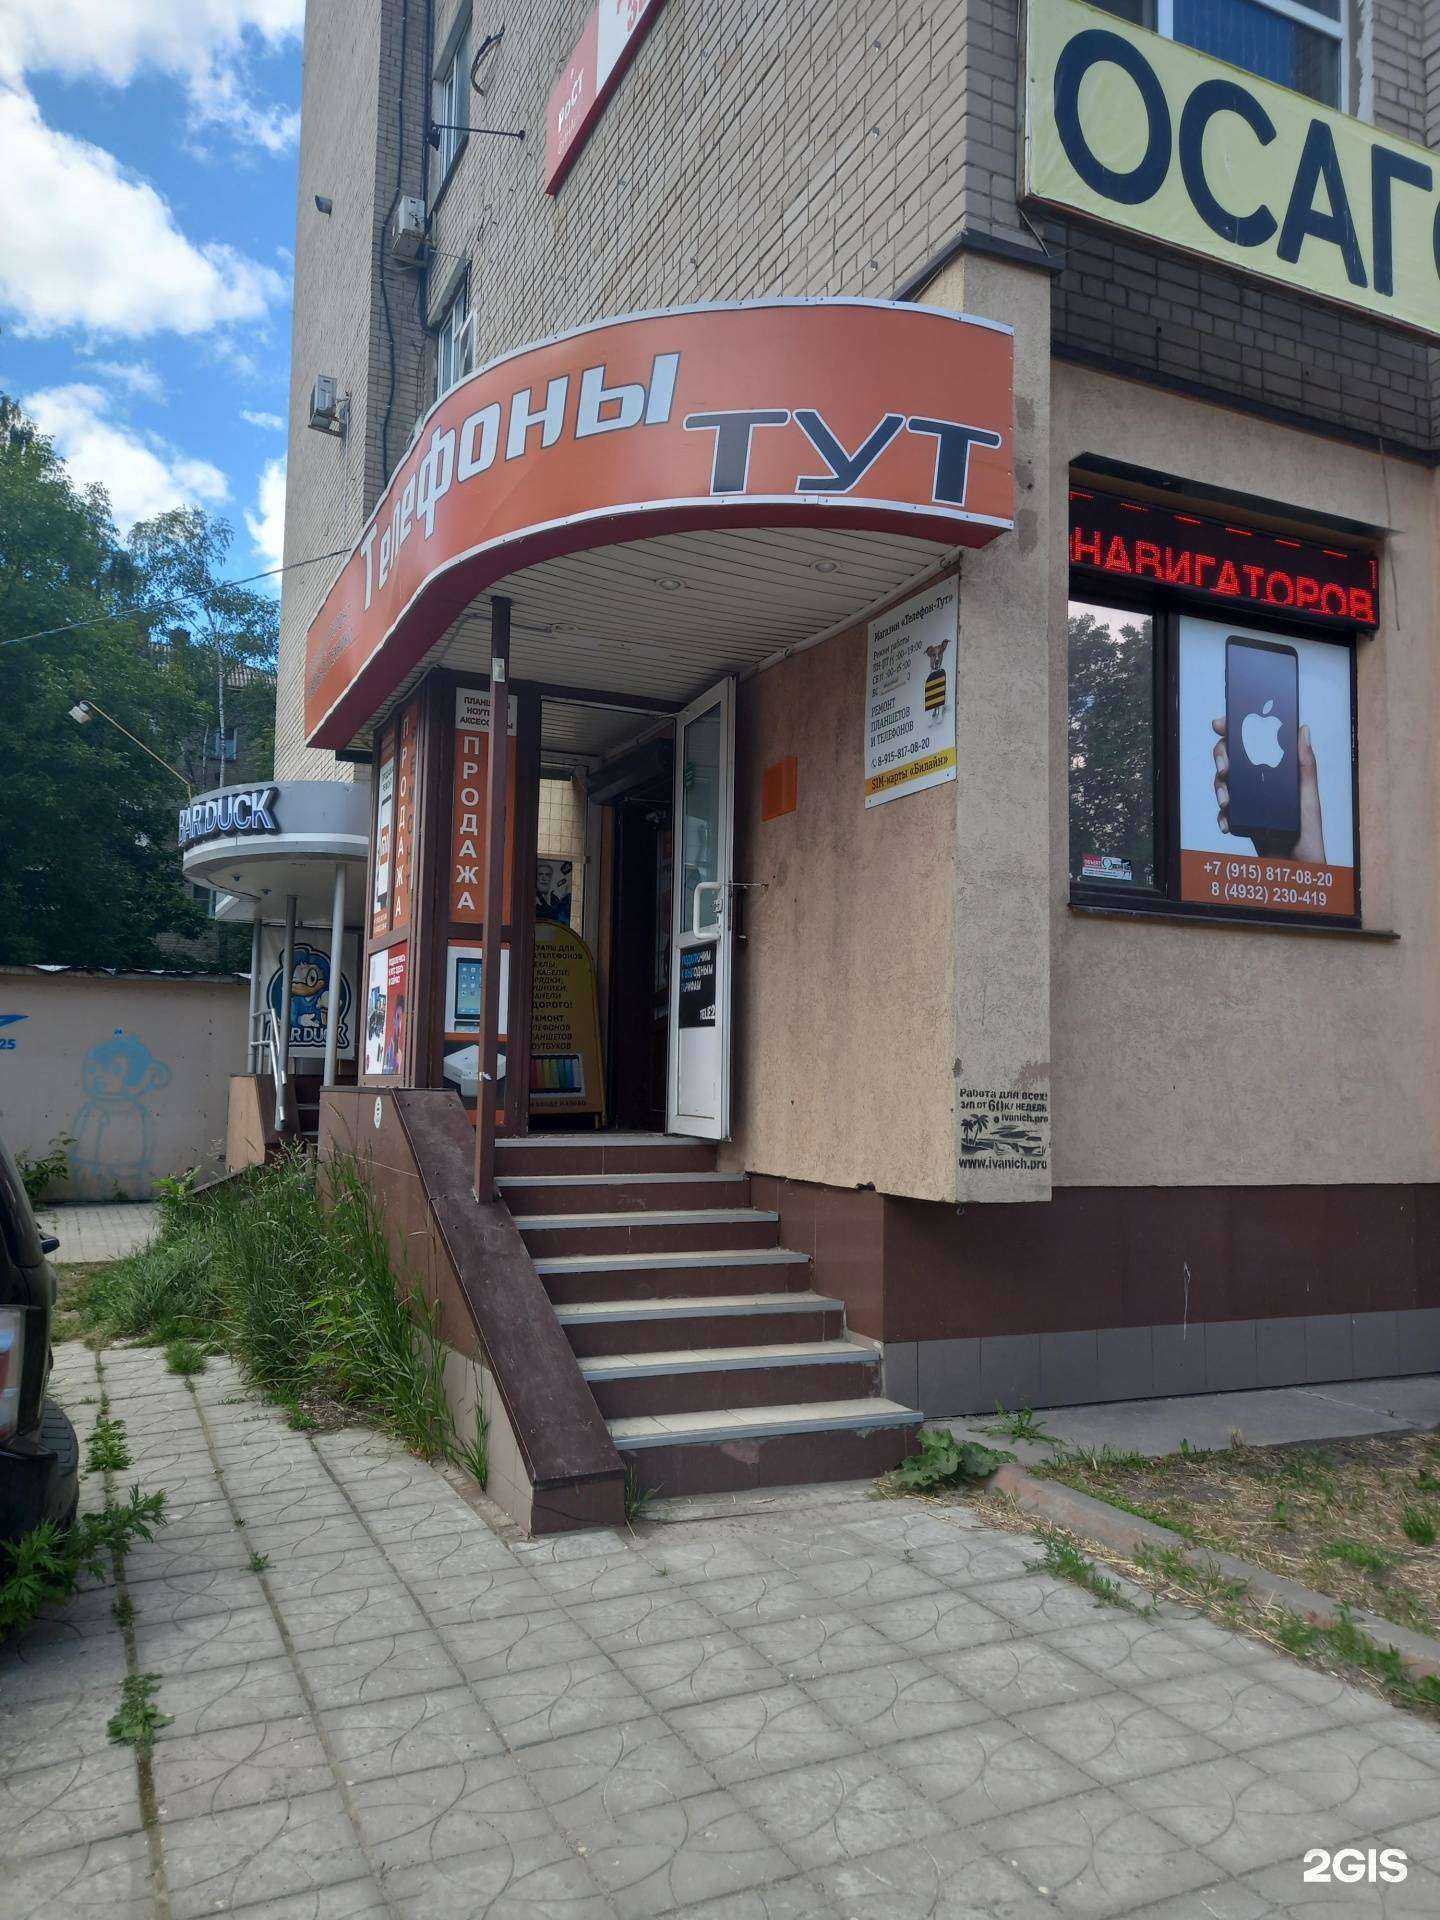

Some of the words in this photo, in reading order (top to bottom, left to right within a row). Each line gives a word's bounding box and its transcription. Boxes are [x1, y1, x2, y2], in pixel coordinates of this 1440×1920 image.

[1052, 28, 1440, 296] ОСАГ
[683, 408, 1002, 506] ТУТ
[361, 351, 681, 611] Телефоны
[871, 697, 896, 717] РЕМОНТ
[871, 706, 911, 733] ПЛАНШЕТОВ
[876, 721, 914, 744] ТЕЛЕФОНОВ
[395, 717, 409, 917] ПРОДАЖА
[456, 735, 480, 910] ПРОДАЖА
[1203, 860, 1222, 876] +7
[1226, 862, 1262, 883] (915)
[1265, 866, 1334, 887] 817-08-20
[1211, 881, 1220, 896] 8
[1224, 882, 1269, 904] (4932)
[1273, 887, 1327, 906] 230-419
[960, 1089, 996, 1098] Работа
[959, 1157, 1047, 1170] www.ivanich.pro
